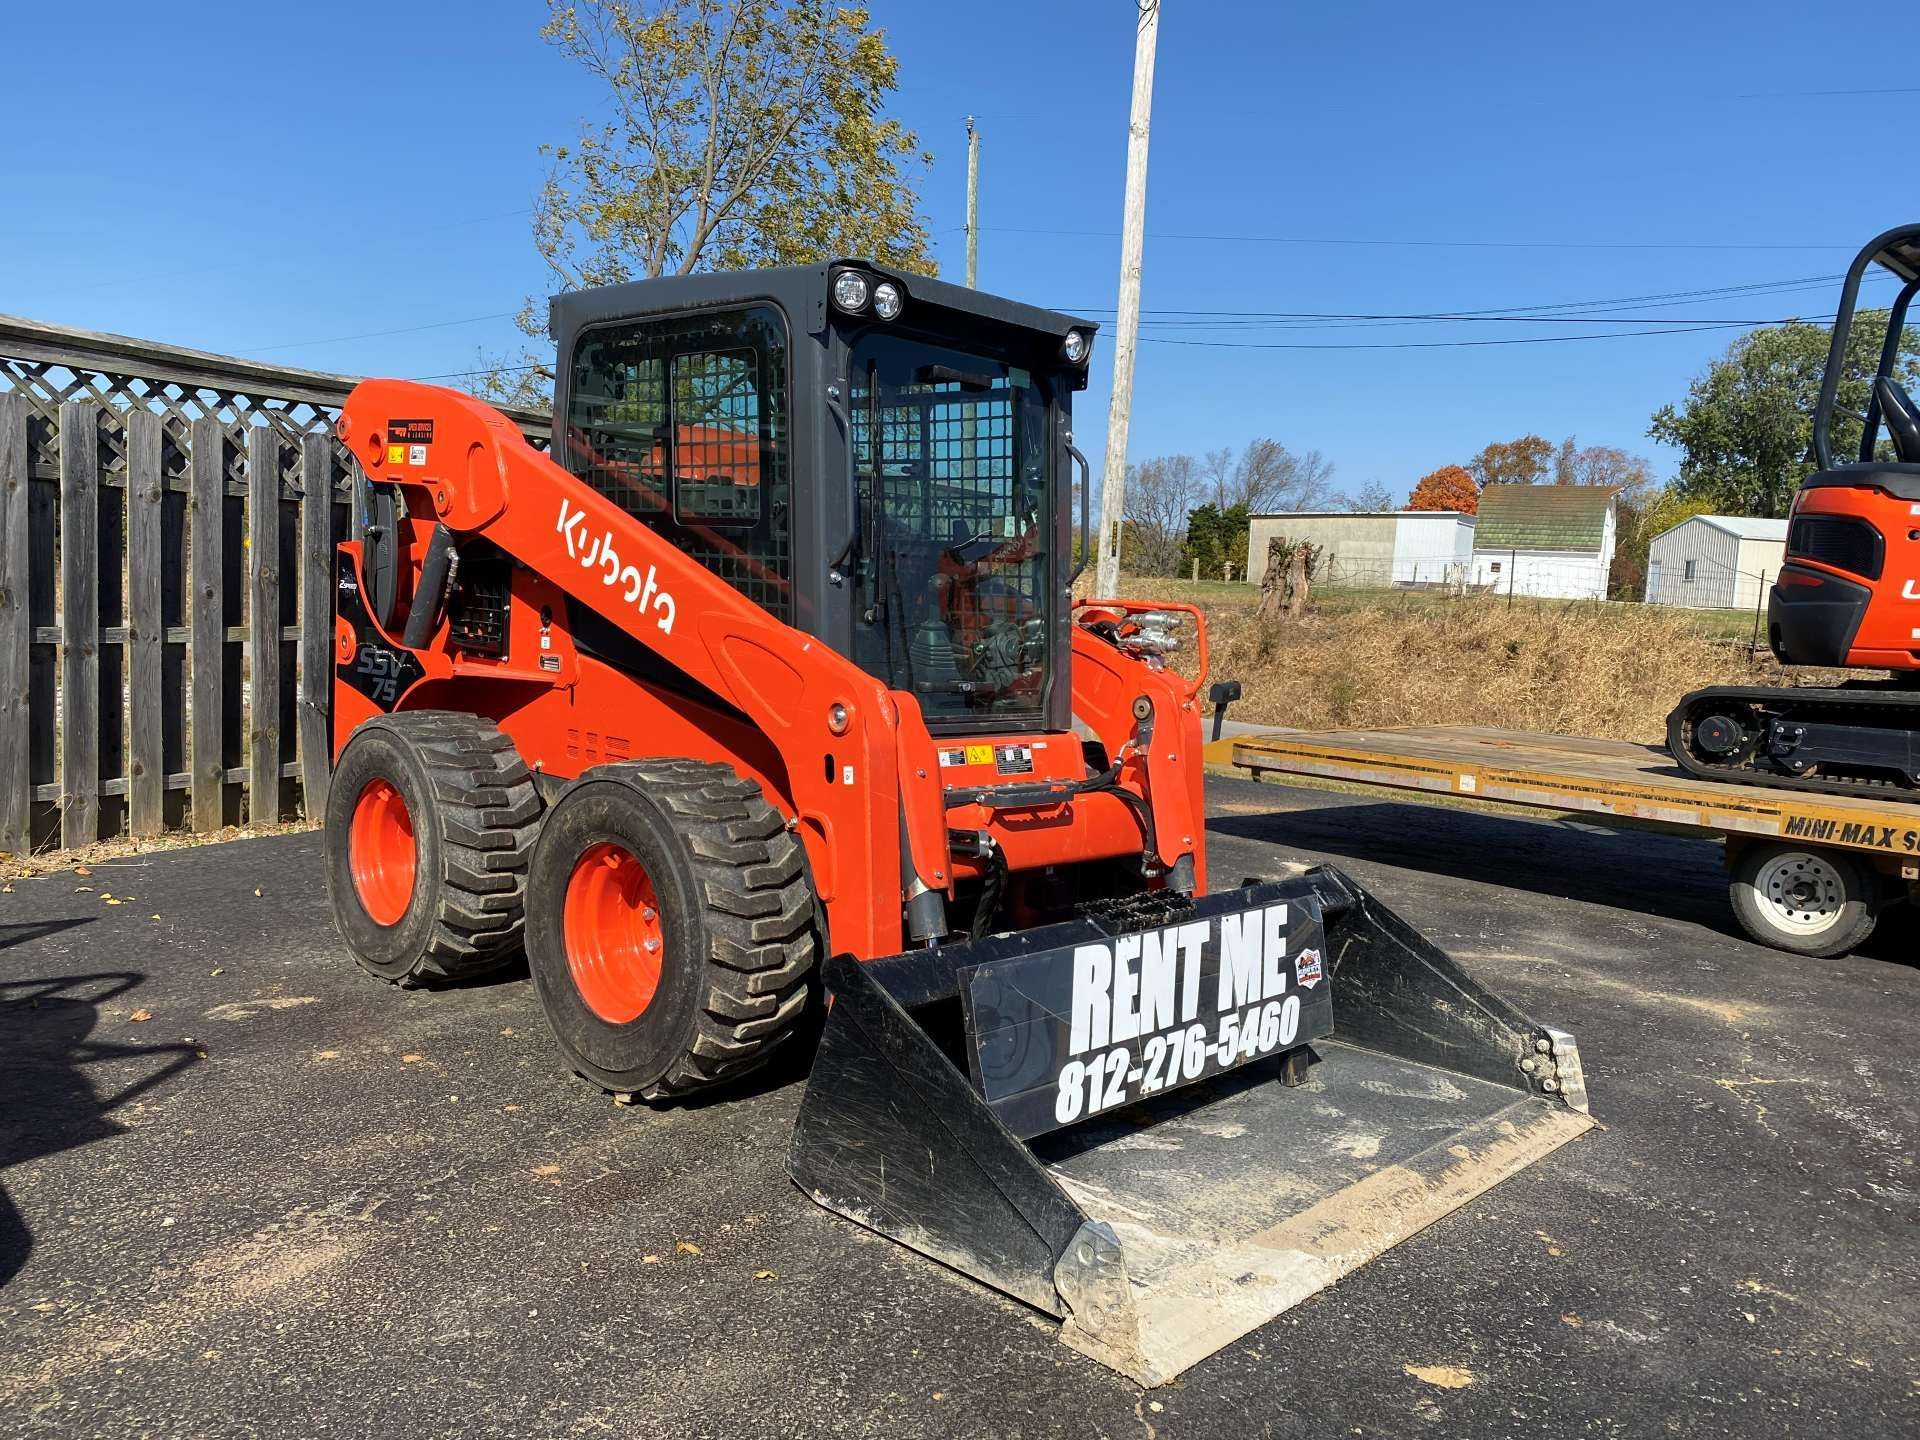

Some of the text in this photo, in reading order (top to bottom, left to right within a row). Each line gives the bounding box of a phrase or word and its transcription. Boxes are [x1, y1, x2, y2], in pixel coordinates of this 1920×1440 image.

[556, 498, 676, 635] Kubota
[357, 647, 407, 679] SSV
[372, 677, 397, 702] 75
[1785, 815, 1897, 848] MINI-MAX
[1069, 904, 1288, 1056] RENT ME
[1055, 995, 1301, 1124] 812-276-5460
